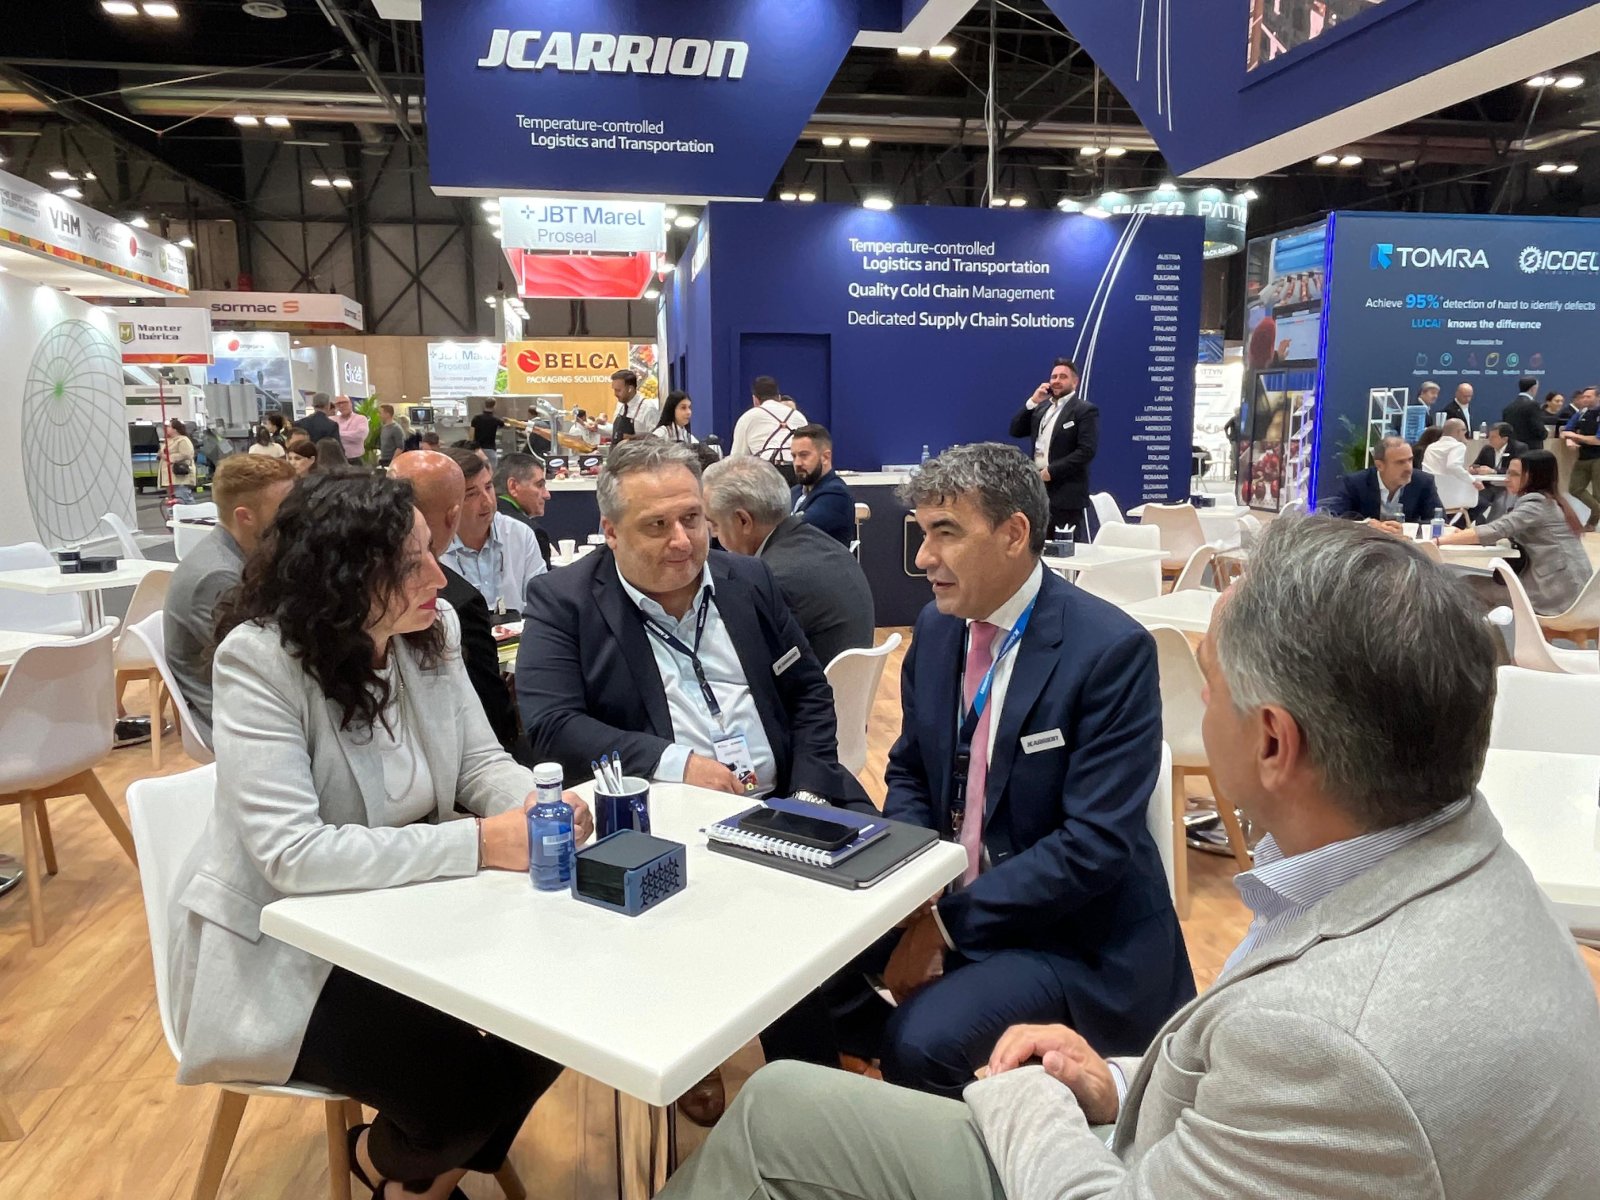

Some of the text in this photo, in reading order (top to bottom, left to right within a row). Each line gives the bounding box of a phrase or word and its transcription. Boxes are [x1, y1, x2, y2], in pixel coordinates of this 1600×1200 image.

[477, 29, 749, 78] JCARRION
[515, 114, 664, 135] Temperature-controlled
[531, 132, 714, 153] Logistics and Transportation
[49, 207, 81, 237] VHM
[538, 206, 645, 226] JBT Marel
[537, 228, 597, 244] Proseal
[849, 238, 995, 256] Temperature-controlled
[863, 256, 1050, 275] Logistics and Transportation
[1396, 247, 1489, 268] TOMRA
[1541, 251, 1600, 271] ICOEL
[848, 282, 1055, 302] Quality Cold Chain Management
[211, 303, 277, 313] sormac
[1365, 298, 1403, 308] Achieve
[1443, 299, 1485, 309] detection
[1487, 300, 1496, 309] of
[1498, 300, 1518, 309] hard
[1520, 301, 1529, 310] to
[1531, 300, 1562, 312] identify
[1564, 301, 1596, 311] defects
[138, 324, 182, 332] Manter
[848, 310, 1075, 329] Dedicated Supply Chain Solutions
[1447, 319, 1477, 328] knows
[1479, 319, 1494, 328] the
[1496, 319, 1541, 329] difference
[139, 333, 179, 341] Ibérica
[545, 353, 619, 369] BELCA
[526, 375, 572, 384] PACKAGING
